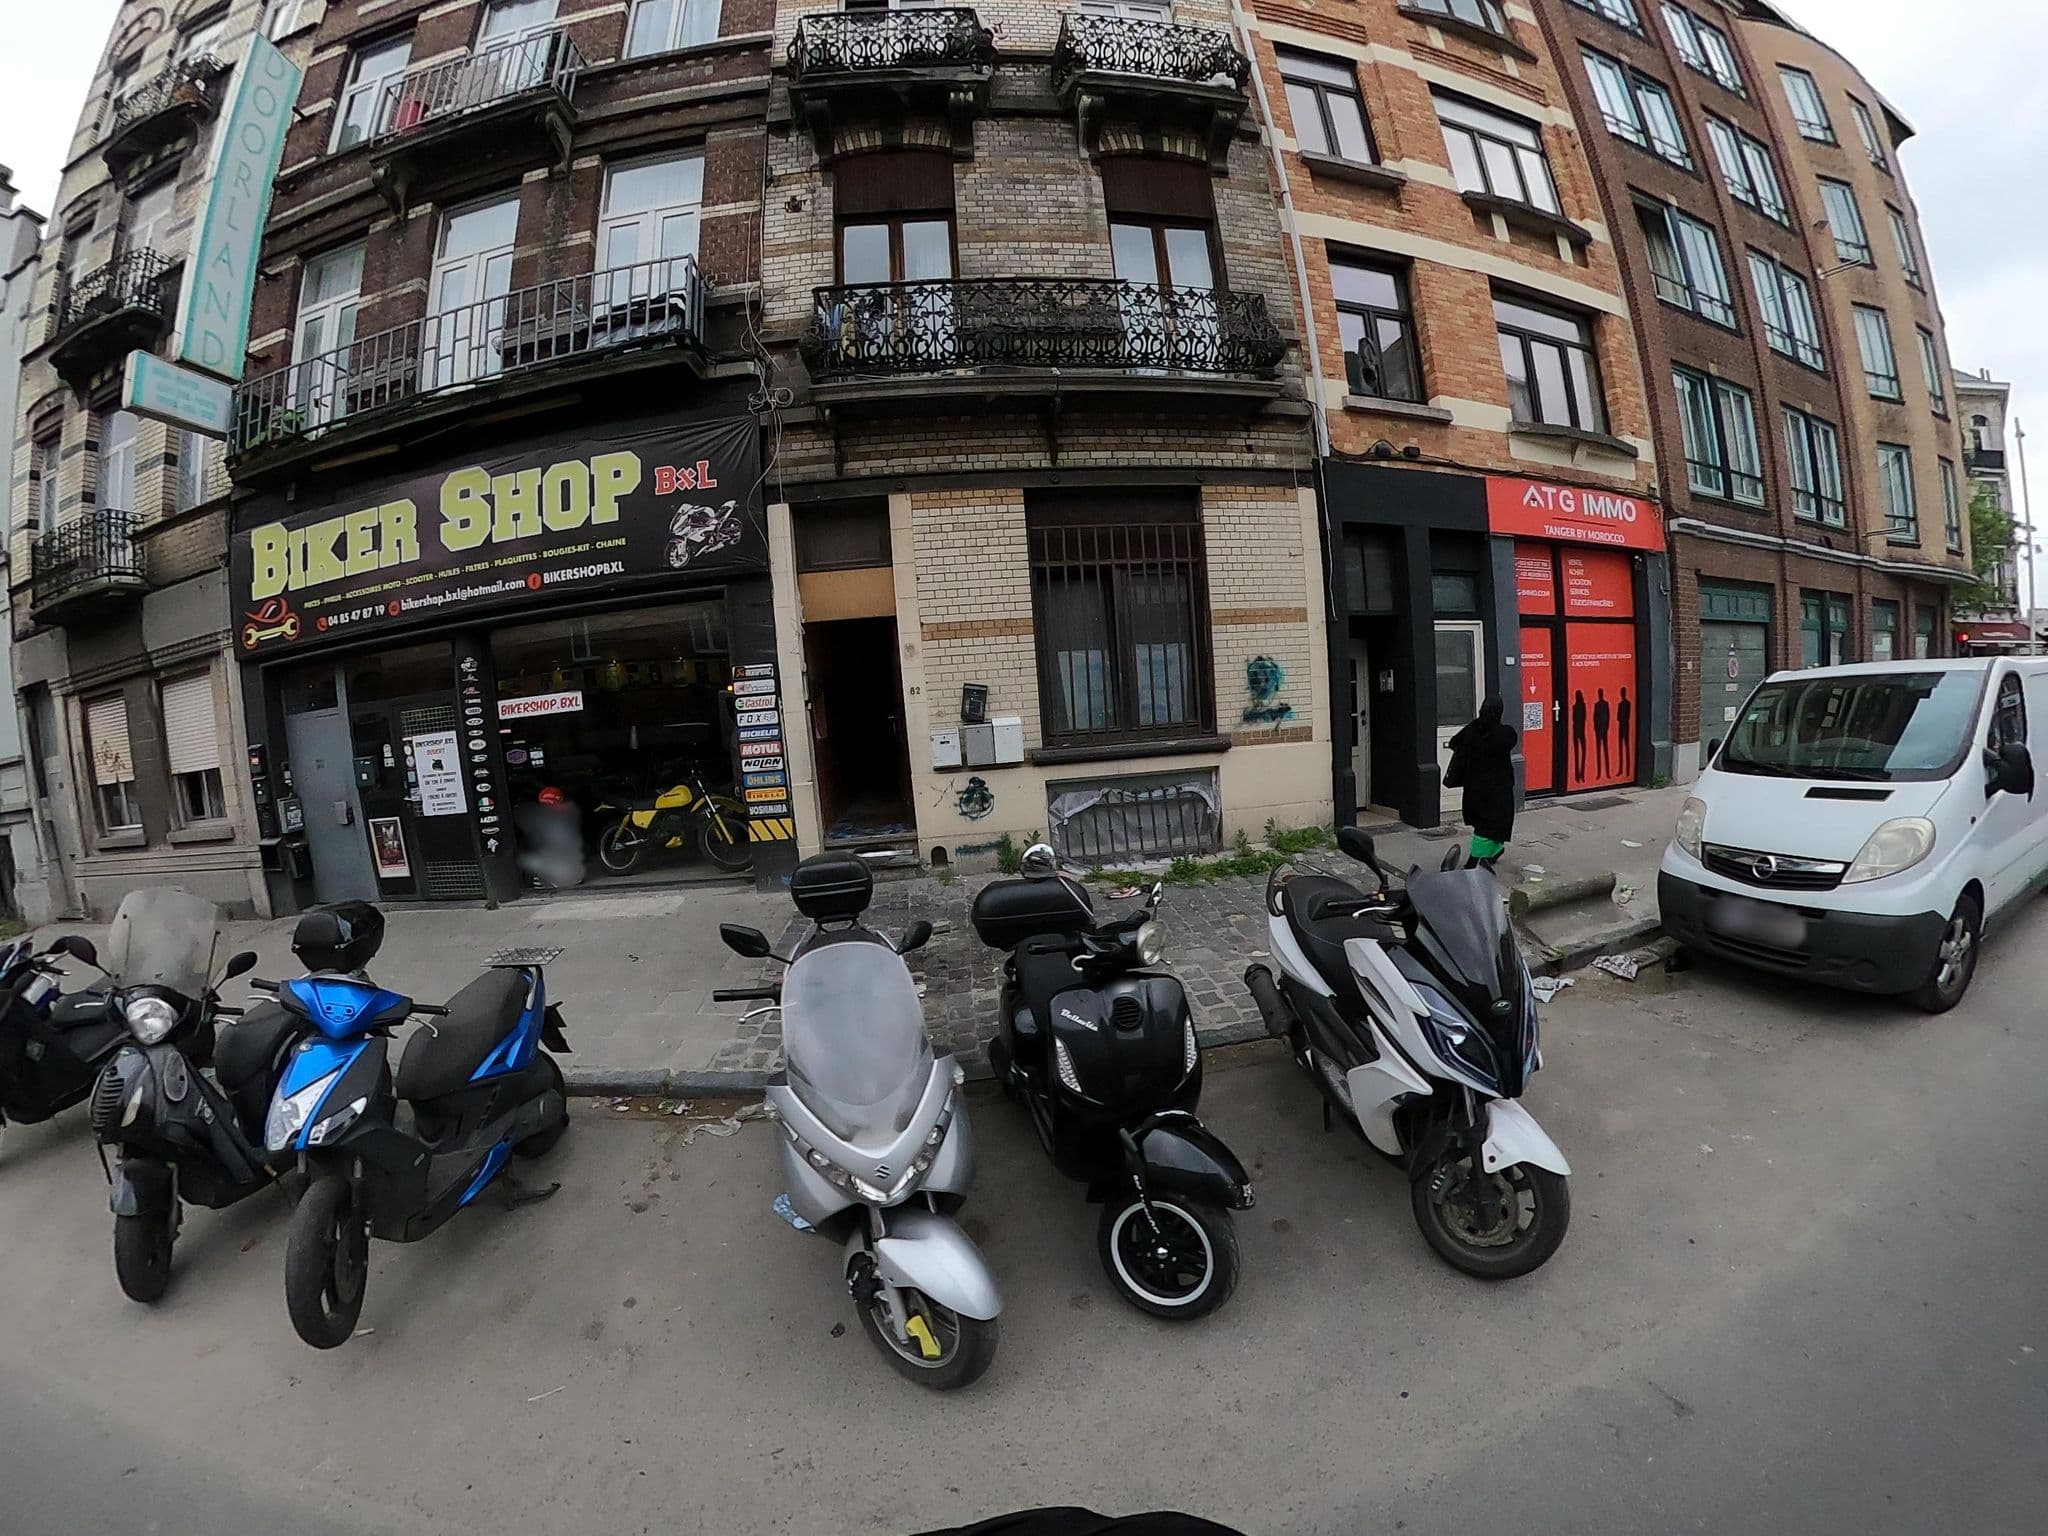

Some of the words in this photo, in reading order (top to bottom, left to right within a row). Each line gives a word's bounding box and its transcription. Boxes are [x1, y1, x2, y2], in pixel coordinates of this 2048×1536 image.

[202, 46, 286, 366] DOORLAND
[1523, 485, 1575, 512] ATG
[1582, 493, 1637, 522] IMMO
[251, 498, 420, 601] BIKER
[440, 450, 642, 552] SHOP
[1543, 525, 1576, 538] TANGER
[1577, 529, 1587, 539] BY
[1588, 531, 1625, 543] MOROCCO
[382, 580, 401, 591] MOTO
[406, 572, 434, 586] SCOOTER
[438, 567, 461, 579] HUILES
[465, 561, 490, 573] FILTRES
[494, 552, 537, 567] PLAQUETTES
[596, 537, 627, 549] CHAINE
[328, 615, 338, 626] 04
[339, 613, 349, 624] 85
[351, 610, 361, 621] 47
[362, 607, 373, 618] 87
[375, 605, 385, 616] 19
[401, 579, 525, 610] bikershop.bxl@hotmail.com
[543, 561, 624, 584] BIKERSHOPBXL
[500, 695, 581, 716] BIKERSHOP.BXL
[745, 697, 773, 708] Castrol
[739, 714, 761, 724] FOX
[740, 728, 779, 738] MICHELIN
[742, 743, 780, 755] MOTUL
[744, 758, 781, 768] NOLAN
[747, 773, 781, 785] ÖHLINS
[747, 789, 785, 799] PIRELLI
[749, 803, 788, 815] YOSHIMURA
